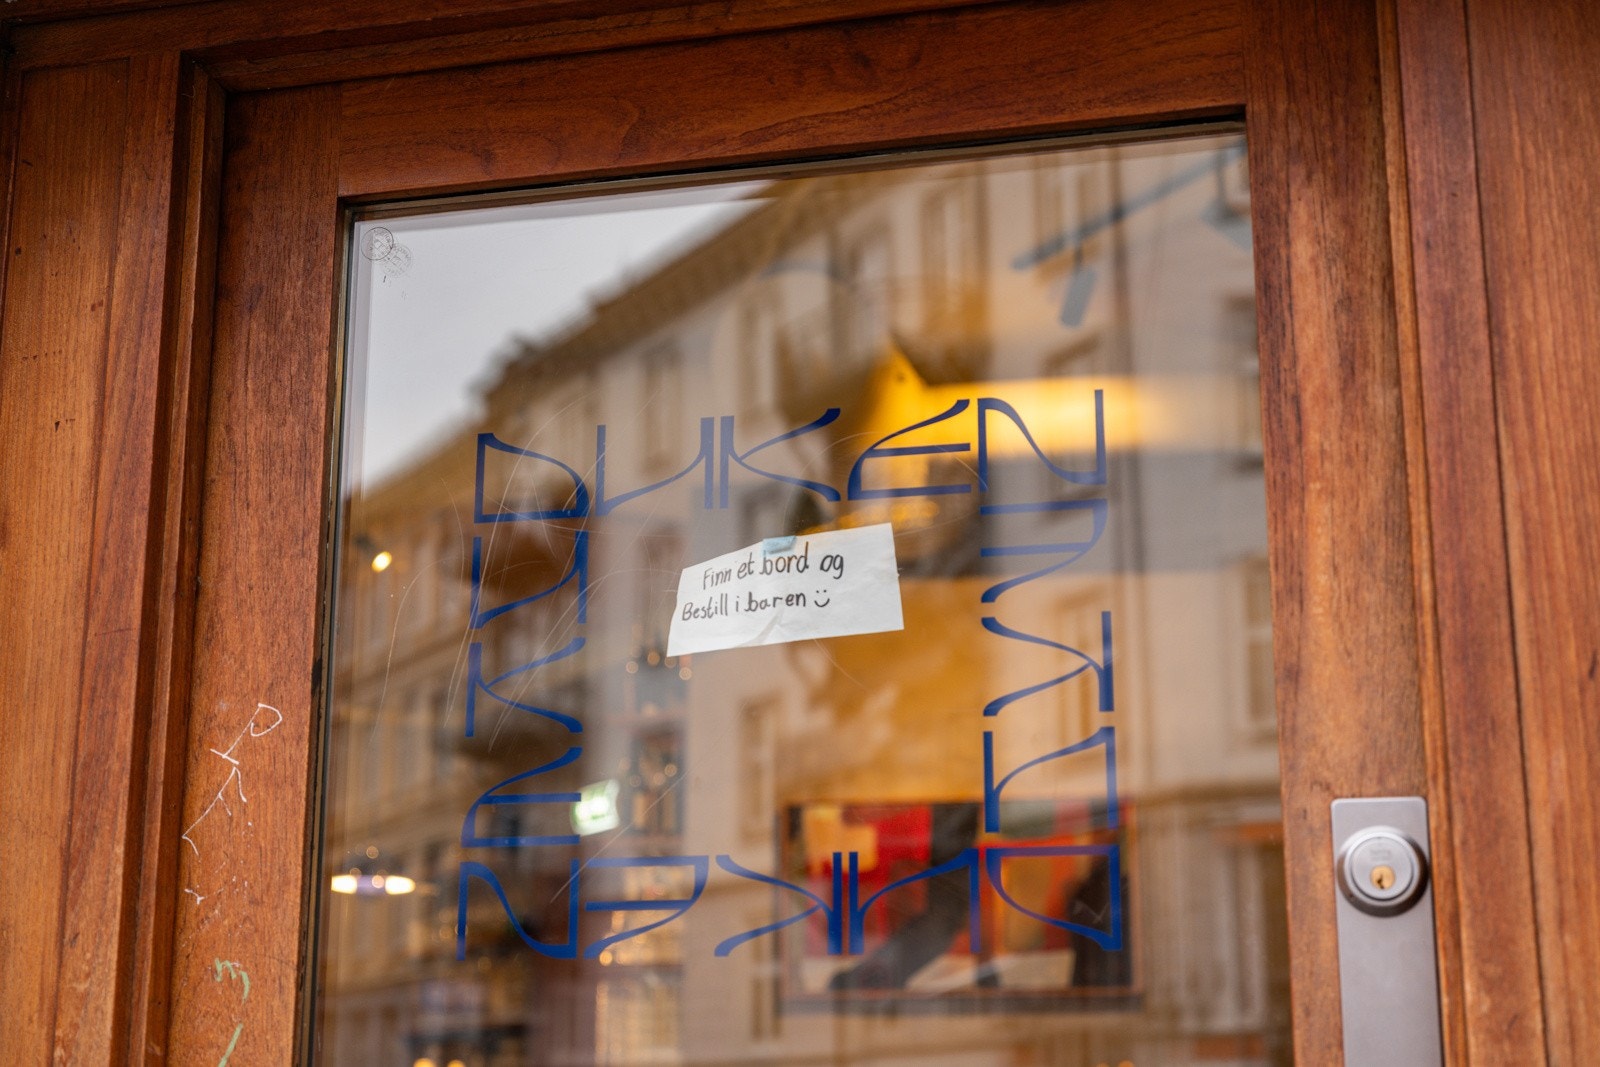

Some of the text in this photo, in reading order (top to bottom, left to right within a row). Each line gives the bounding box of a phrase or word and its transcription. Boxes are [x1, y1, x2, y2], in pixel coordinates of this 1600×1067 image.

[474, 389, 1106, 523] DUKEN
[703, 541, 845, 590] Finn et bord og
[682, 593, 728, 621] Bestill
[744, 592, 806, 612] baren
